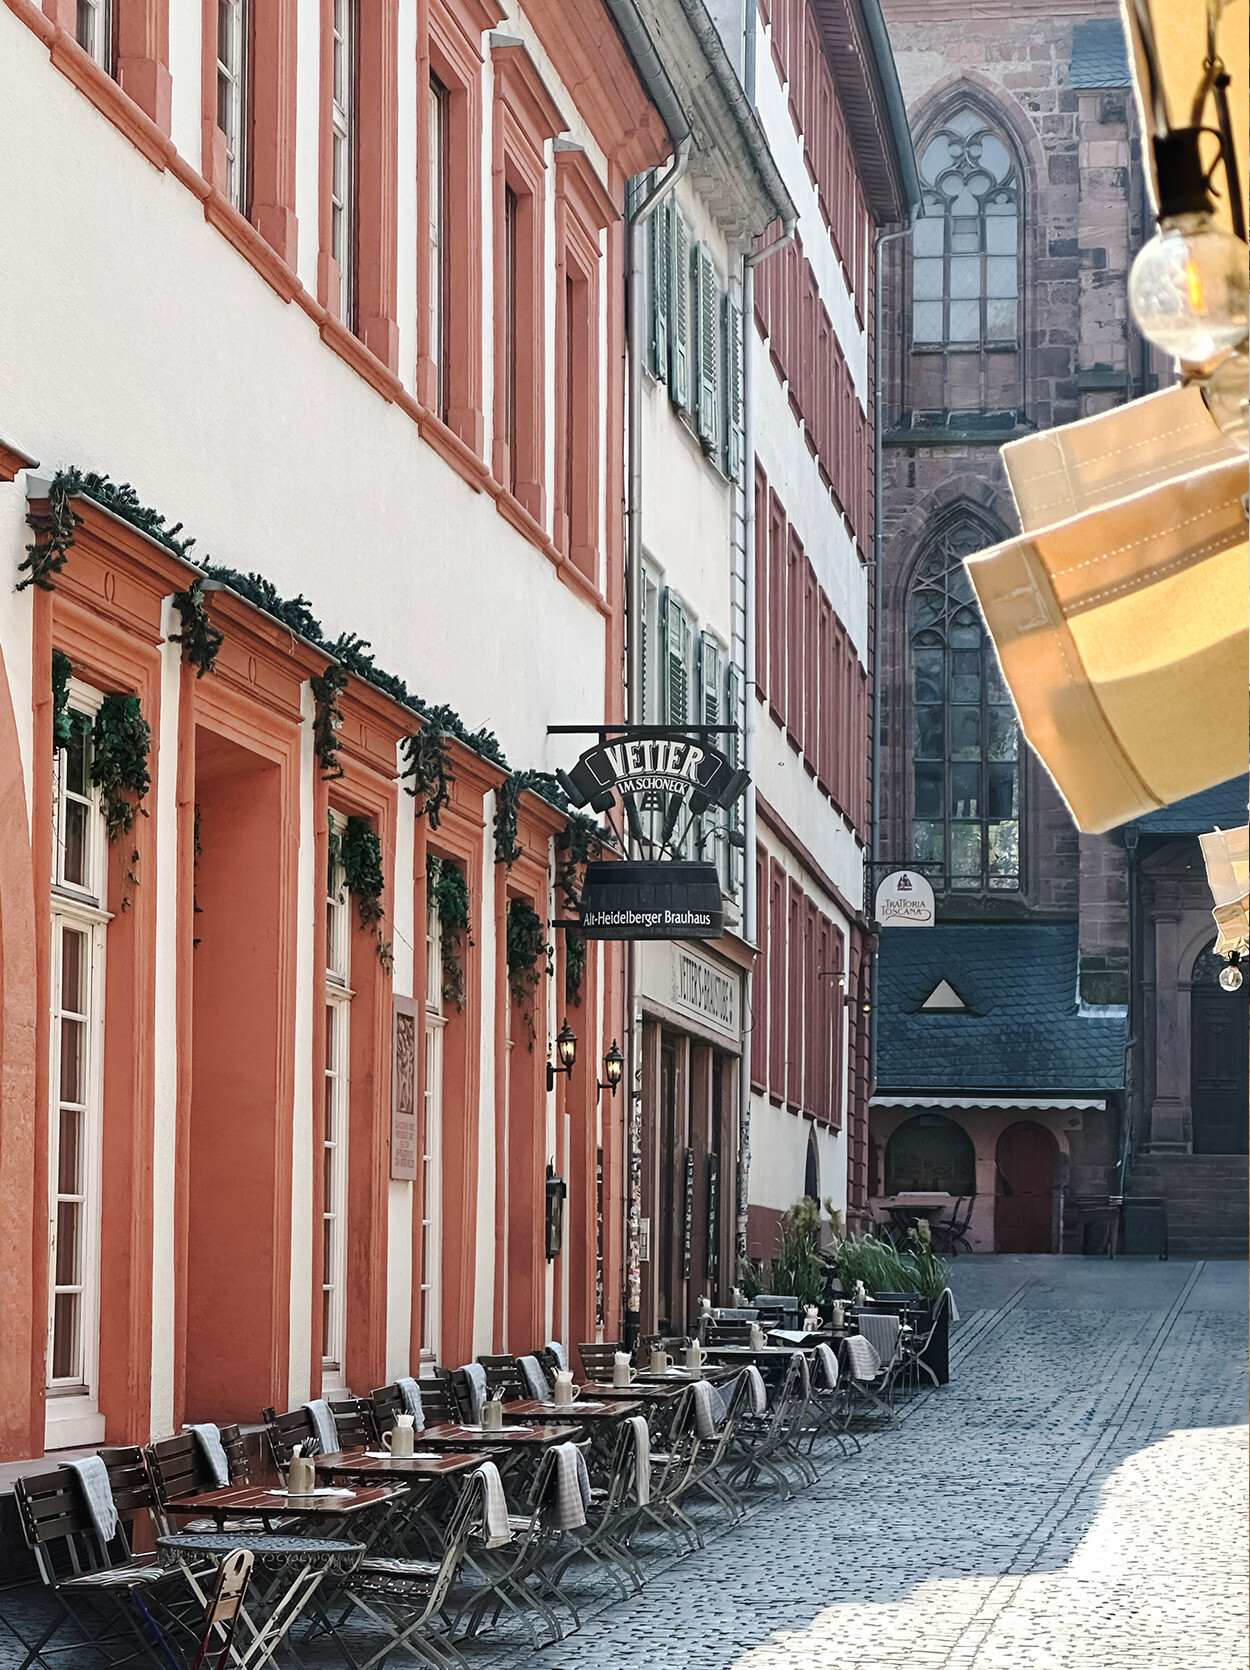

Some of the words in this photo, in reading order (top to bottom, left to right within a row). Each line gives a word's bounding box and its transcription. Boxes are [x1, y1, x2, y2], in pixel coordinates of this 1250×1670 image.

[603, 739, 705, 783] VETTER
[617, 780, 636, 794] IM
[885, 899, 926, 908] TRATTORIA
[881, 906, 922, 916] TOSCANA
[583, 910, 662, 927] Alt-Heidelberger
[664, 910, 711, 925] Brauhaus
